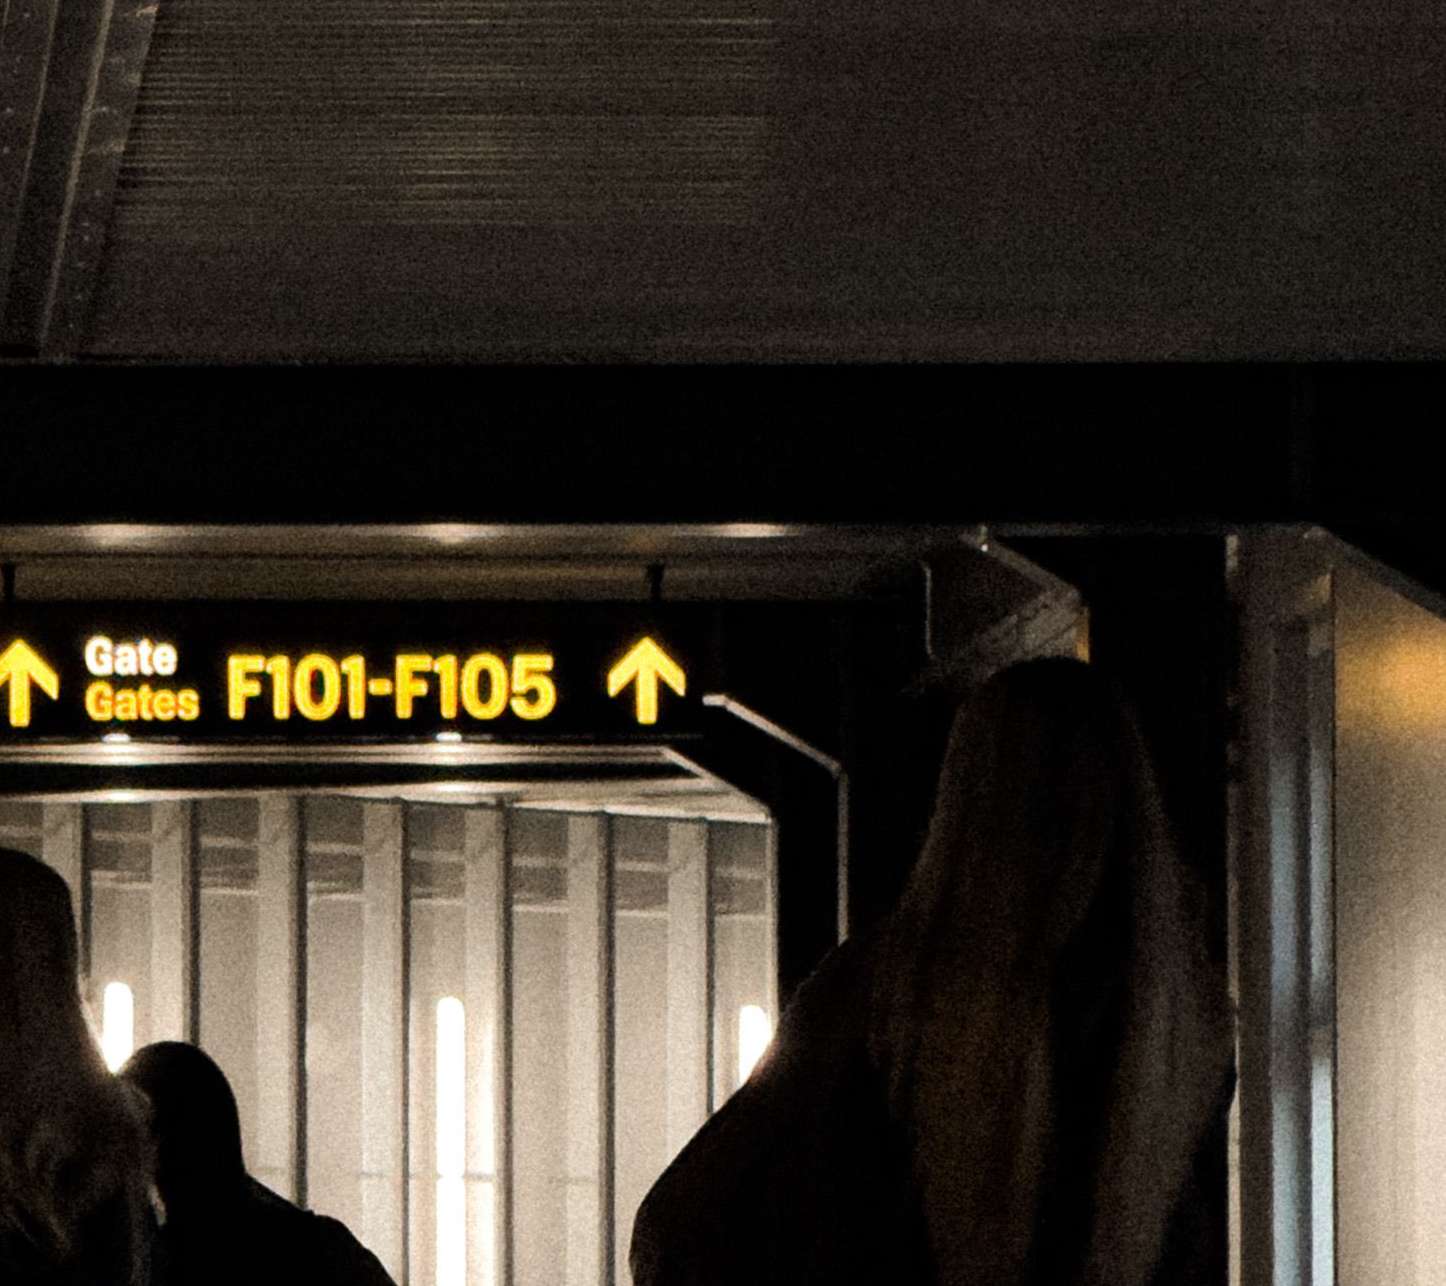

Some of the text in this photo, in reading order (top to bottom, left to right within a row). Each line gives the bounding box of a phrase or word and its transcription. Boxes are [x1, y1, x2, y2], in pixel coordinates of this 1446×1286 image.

[84, 635, 178, 676] Gate
[85, 680, 200, 721] Gates
[226, 652, 557, 721] F101-F105
